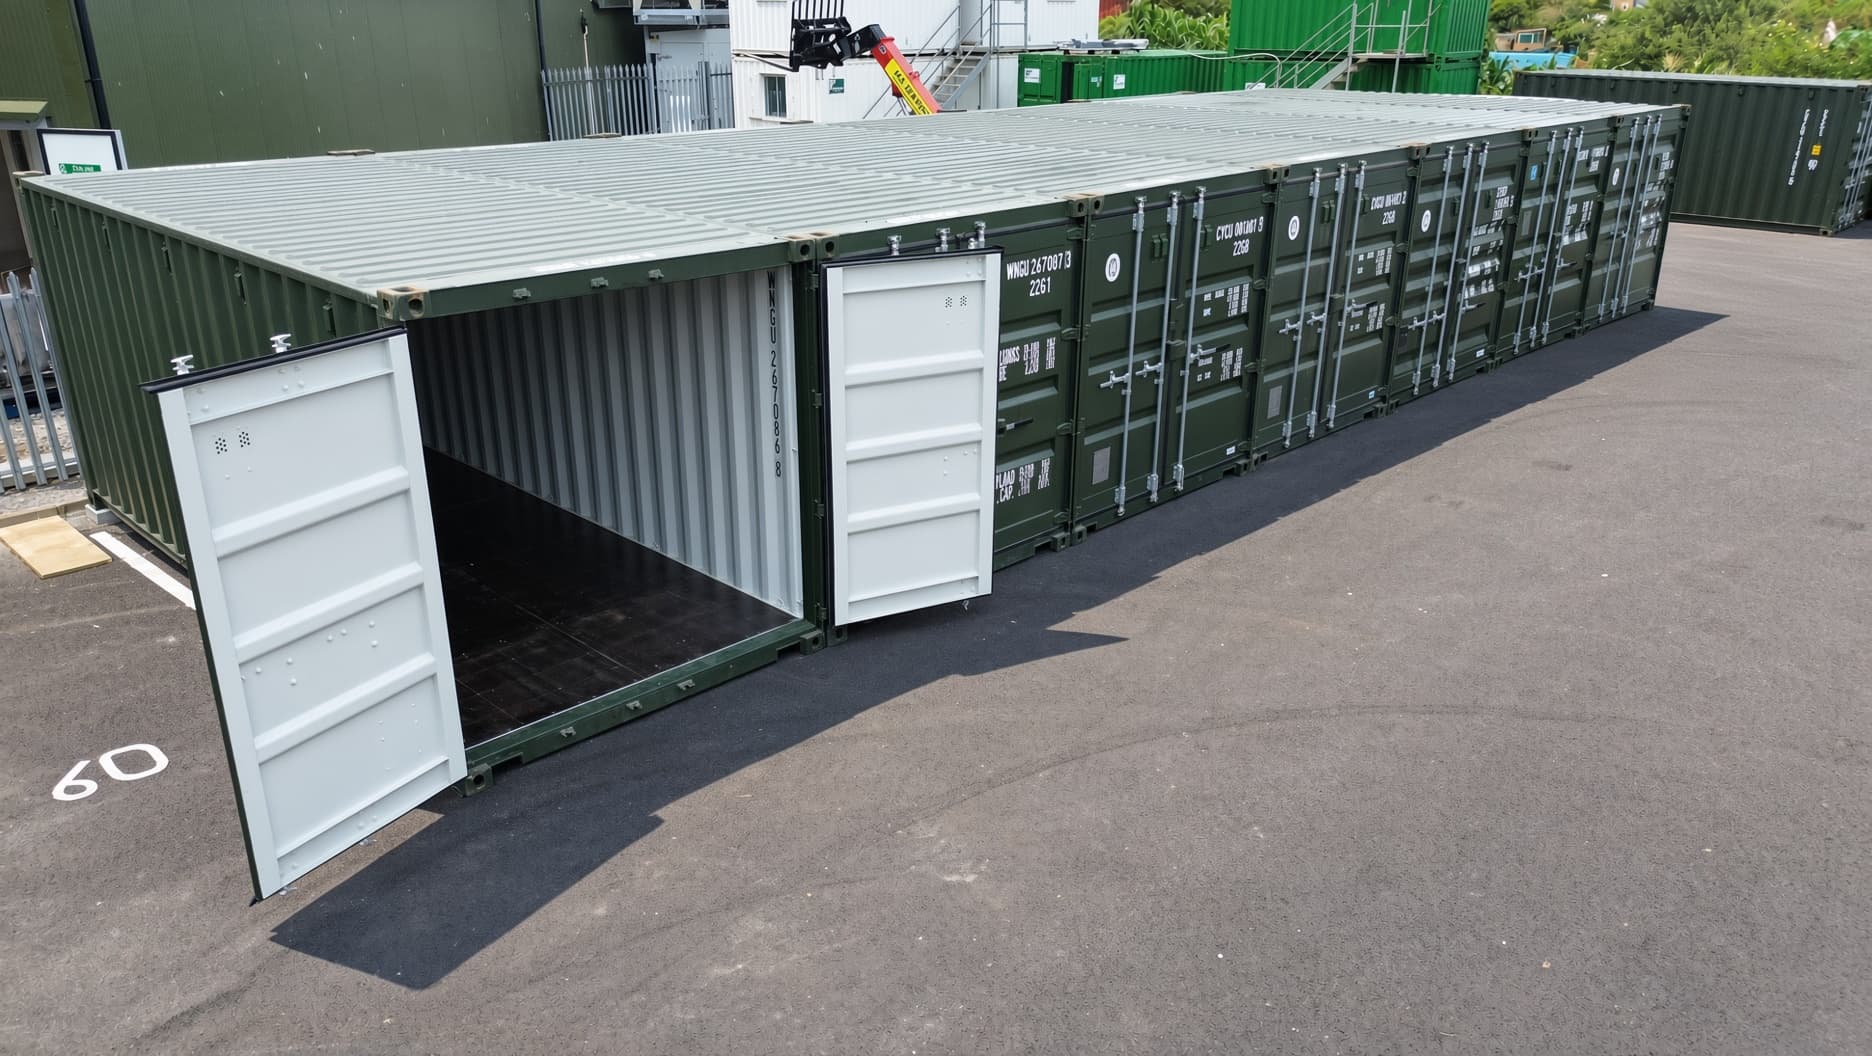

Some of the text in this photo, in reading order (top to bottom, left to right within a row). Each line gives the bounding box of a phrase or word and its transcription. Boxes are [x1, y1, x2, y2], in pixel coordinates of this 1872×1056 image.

[1006, 259, 1030, 281] WNGU
[1030, 252, 1064, 275] 267087
[767, 271, 777, 344] WNGU
[770, 350, 781, 454] 267086
[51, 743, 169, 801] 60
